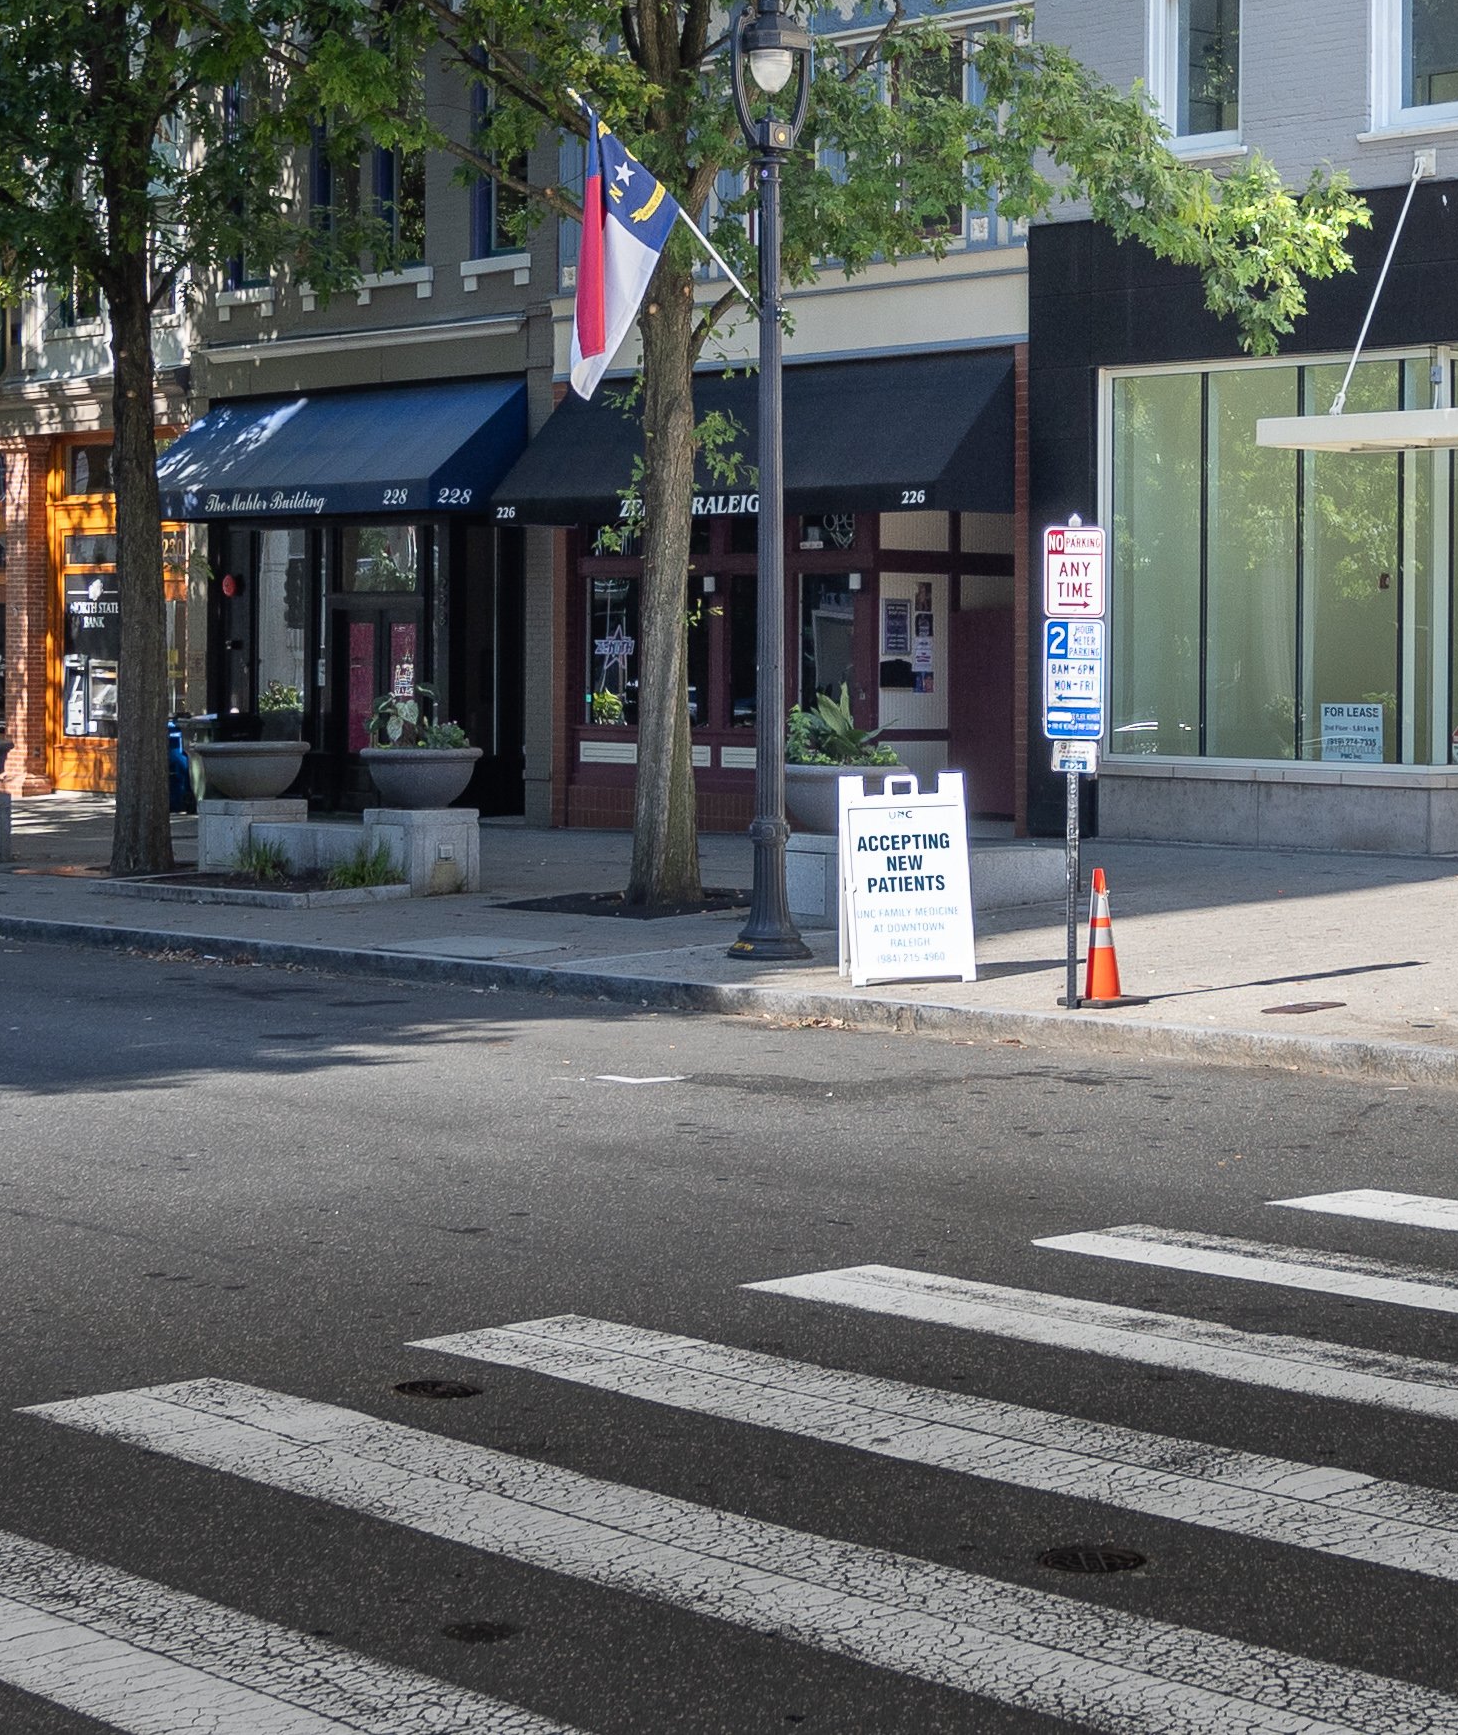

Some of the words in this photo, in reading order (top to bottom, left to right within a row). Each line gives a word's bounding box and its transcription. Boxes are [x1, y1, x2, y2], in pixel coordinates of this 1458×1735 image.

[205, 494, 226, 512] The
[226, 492, 267, 511] Mahler
[270, 490, 327, 514] Building
[382, 488, 408, 505] 228
[437, 487, 472, 504] 228
[691, 494, 760, 515] RALEIG
[901, 490, 926, 505] 226
[496, 506, 516, 519] 226
[162, 538, 183, 558] 230
[1049, 534, 1064, 551] NO
[1066, 537, 1101, 548] PARKING
[1059, 562, 1090, 577] ANY
[1057, 582, 1093, 598] TIME
[70, 602, 97, 614] NORTH
[83, 616, 105, 628] BANK
[1050, 626, 1066, 655] 2
[1074, 636, 1096, 646] METER
[1069, 647, 1100, 657] PARKING
[1324, 707, 1344, 717] FOR
[1346, 707, 1379, 718] LEASE
[889, 810, 913, 820] UNC
[857, 833, 950, 852] ACCEPTING
[886, 855, 923, 871] NEW
[867, 875, 946, 893] PATIENTS
[856, 909, 876, 919] UNC
[879, 907, 912, 917] FAMILY
[915, 906, 959, 916] MEDICINE
[874, 924, 884, 933] AT
[887, 922, 945, 932] DOWNTOWN
[890, 937, 931, 947] RALEIGH
[877, 954, 901, 964] (984)
